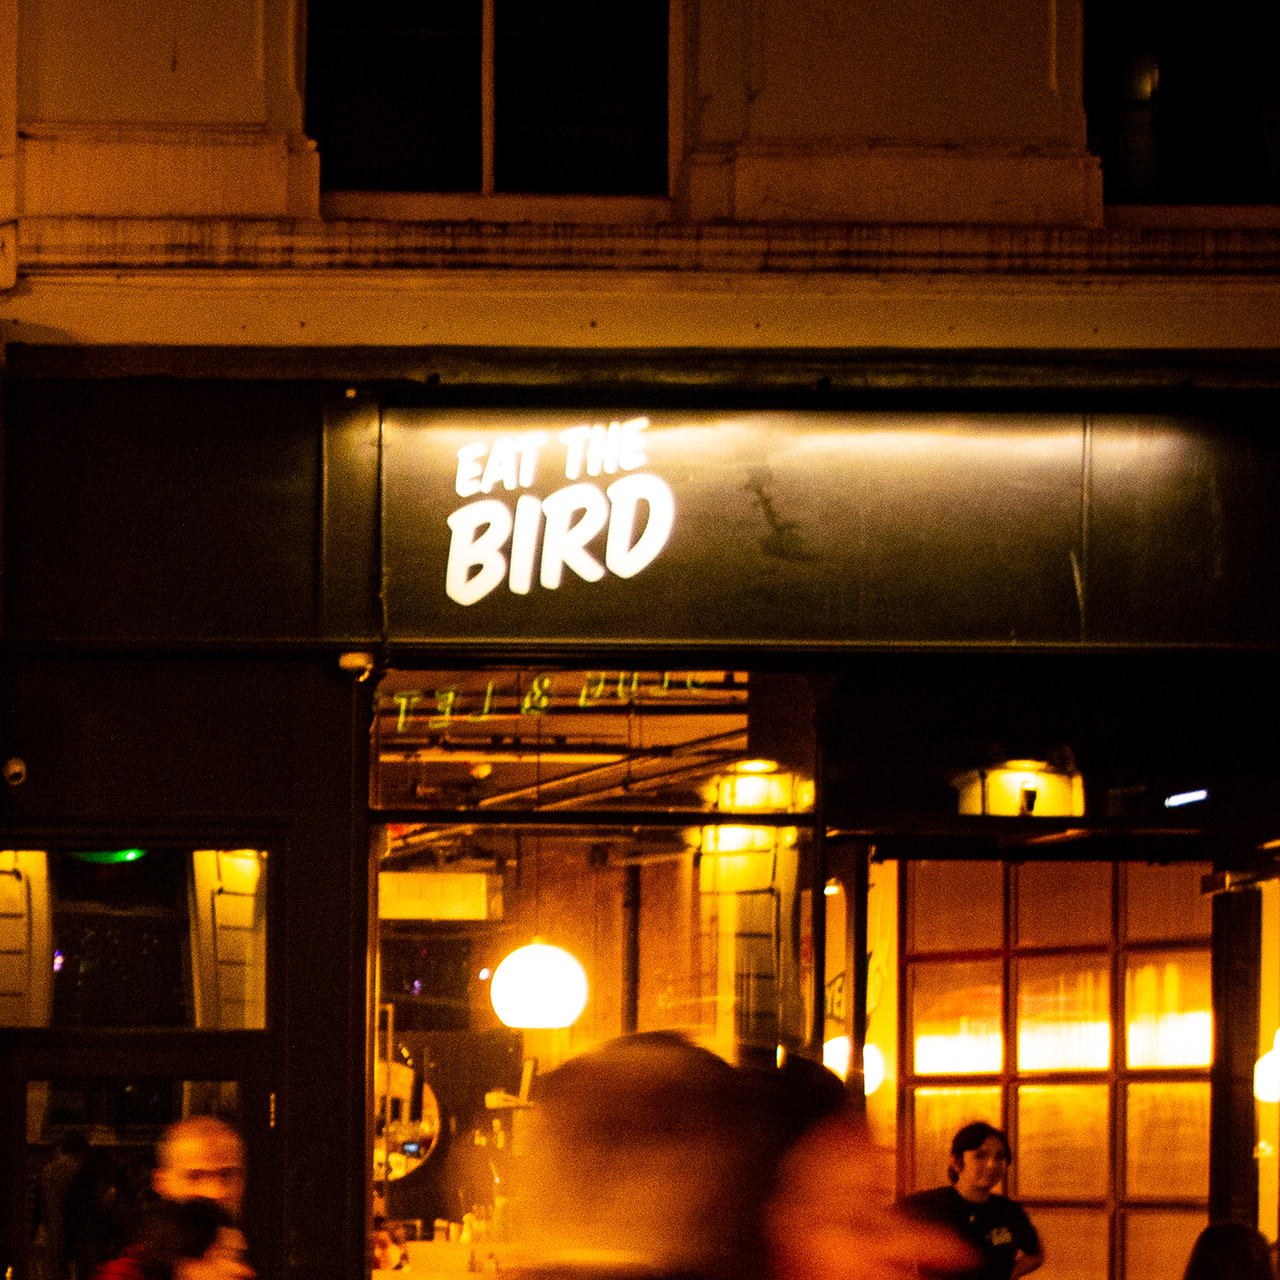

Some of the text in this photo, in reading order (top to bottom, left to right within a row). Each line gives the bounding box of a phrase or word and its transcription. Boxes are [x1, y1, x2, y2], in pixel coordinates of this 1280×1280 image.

[455, 416, 650, 498] EAT THE
[446, 473, 676, 607] BIRD
